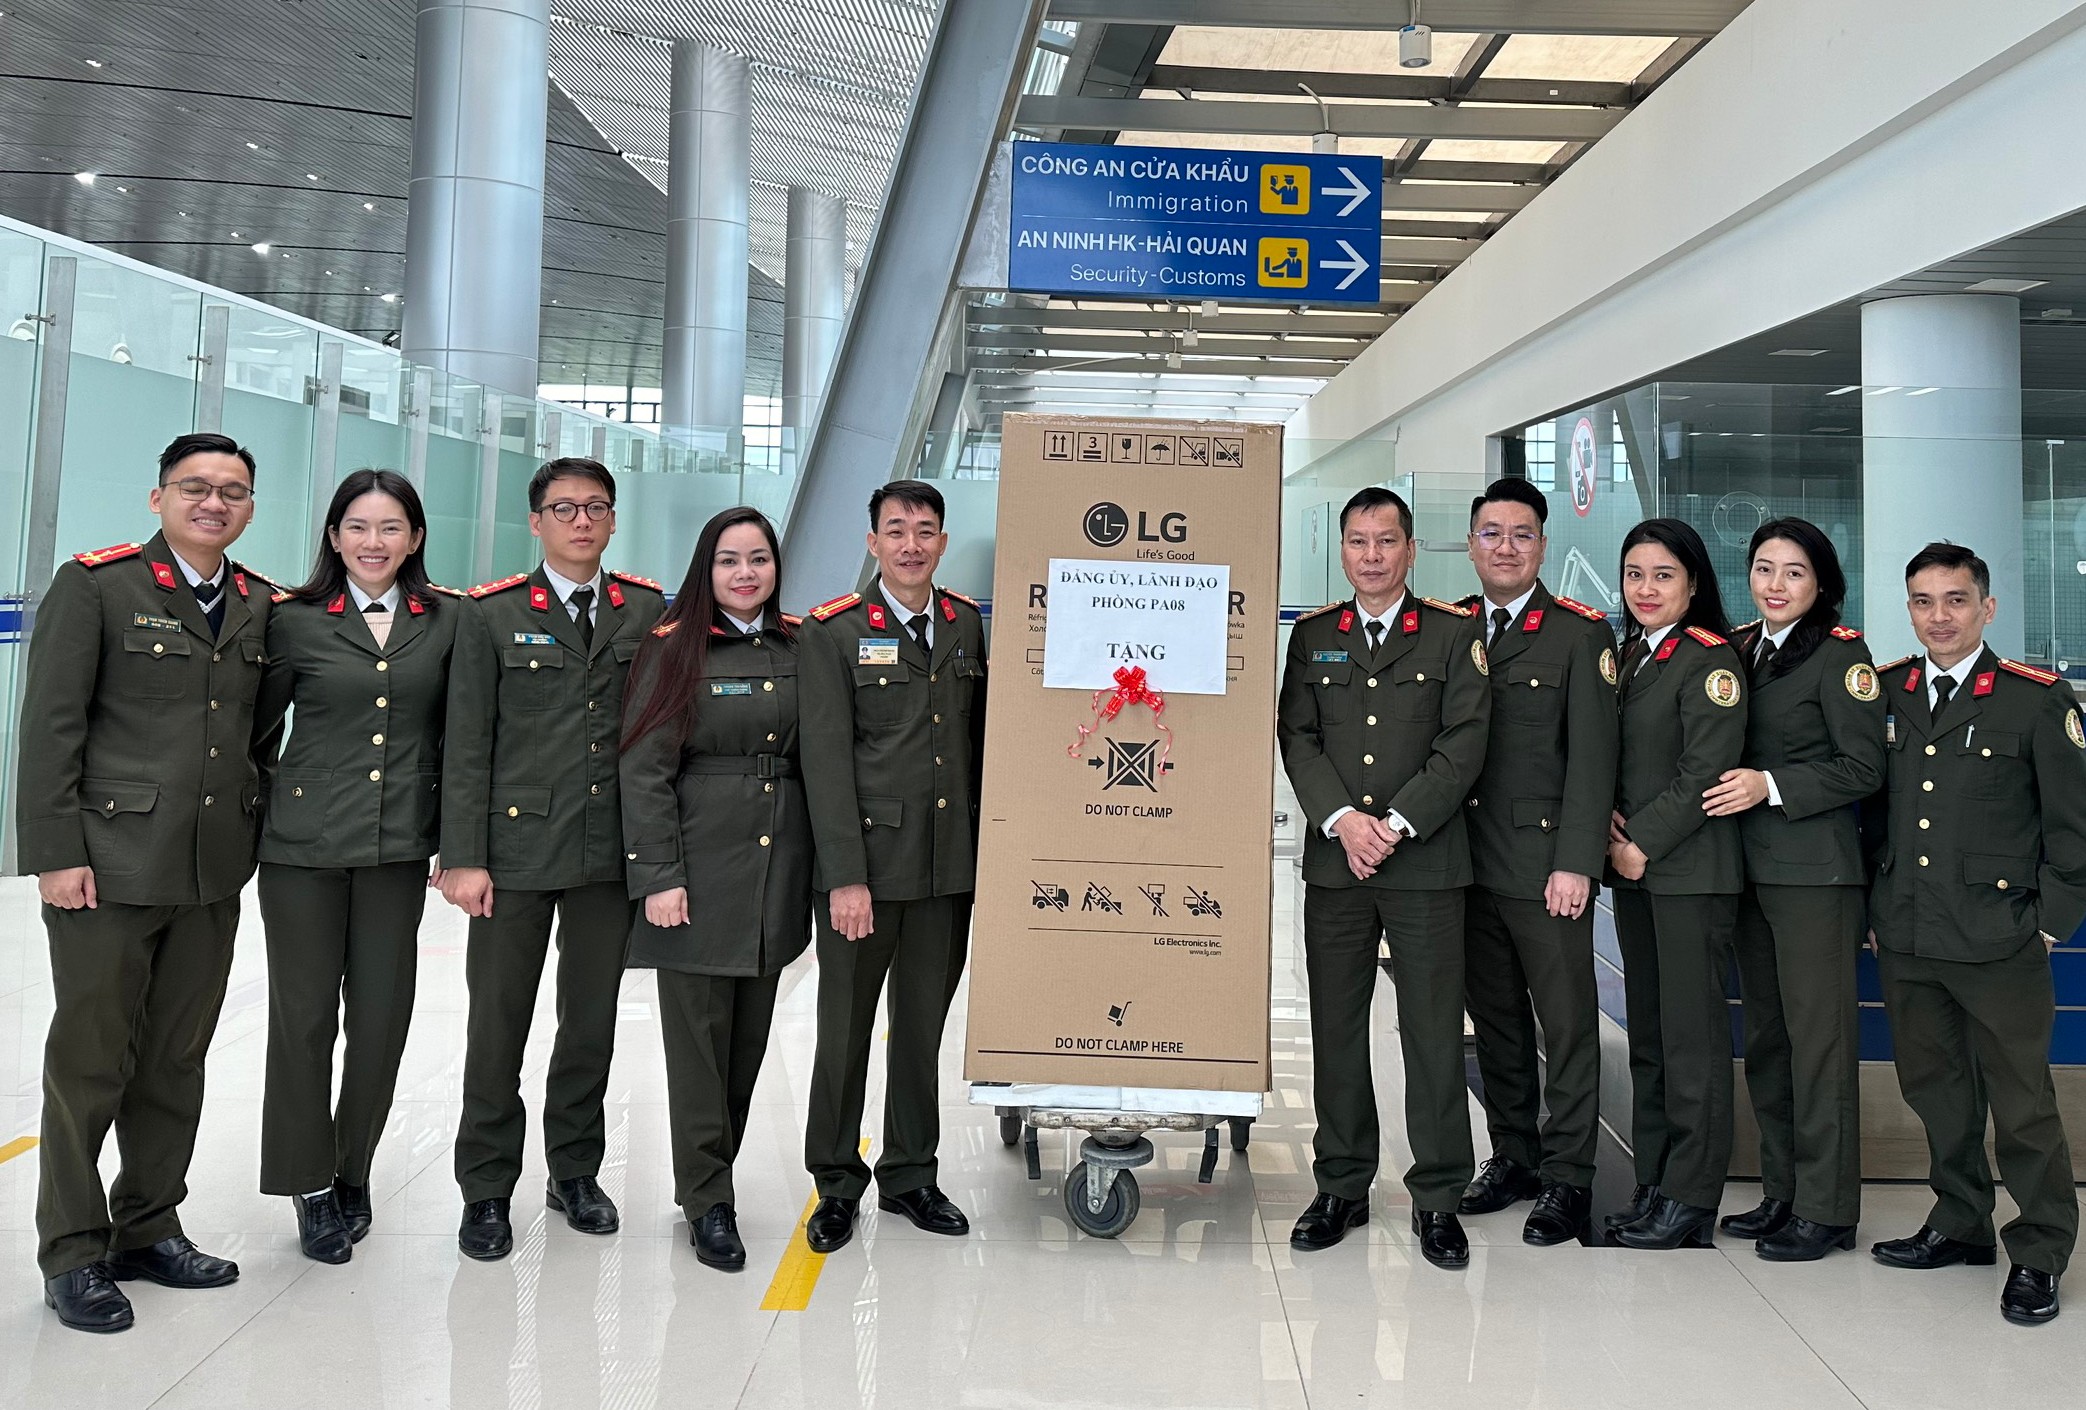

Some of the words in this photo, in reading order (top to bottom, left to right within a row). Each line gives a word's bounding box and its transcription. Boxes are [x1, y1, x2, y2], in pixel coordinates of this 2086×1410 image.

[1021, 153, 1088, 175] CÔNG
[1092, 160, 1125, 177] AN
[1130, 157, 1181, 179] CỬA
[1186, 158, 1249, 182] KHẨU
[1108, 191, 1248, 214] Immigration
[1017, 231, 1048, 248] AN
[1052, 232, 1104, 250] NINH
[1186, 237, 1247, 255] QUAN
[1088, 436, 1097, 449] 3
[1137, 511, 1187, 543] LG
[1136, 548, 1164, 560] Life's
[1166, 550, 1195, 561] Good
[1061, 569, 1105, 584] ĐẢNG
[1138, 572, 1180, 587] LÃNH
[1185, 576, 1218, 591] ĐẠO
[1092, 594, 1146, 610] PHÒNG
[1151, 599, 1185, 611] PA08
[1106, 642, 1165, 663] TẶNG
[1085, 804, 1102, 815] DO
[1105, 804, 1130, 816] NOT
[1132, 805, 1173, 818] CLAMP
[1154, 937, 1165, 946] LG
[1166, 938, 1208, 947] Electronics
[1208, 939, 1222, 948] Inc.
[1055, 1037, 1073, 1049] DO
[1076, 1038, 1103, 1050] NOT
[1105, 1039, 1149, 1052] CLAMP
[1151, 1041, 1183, 1053] HERE
